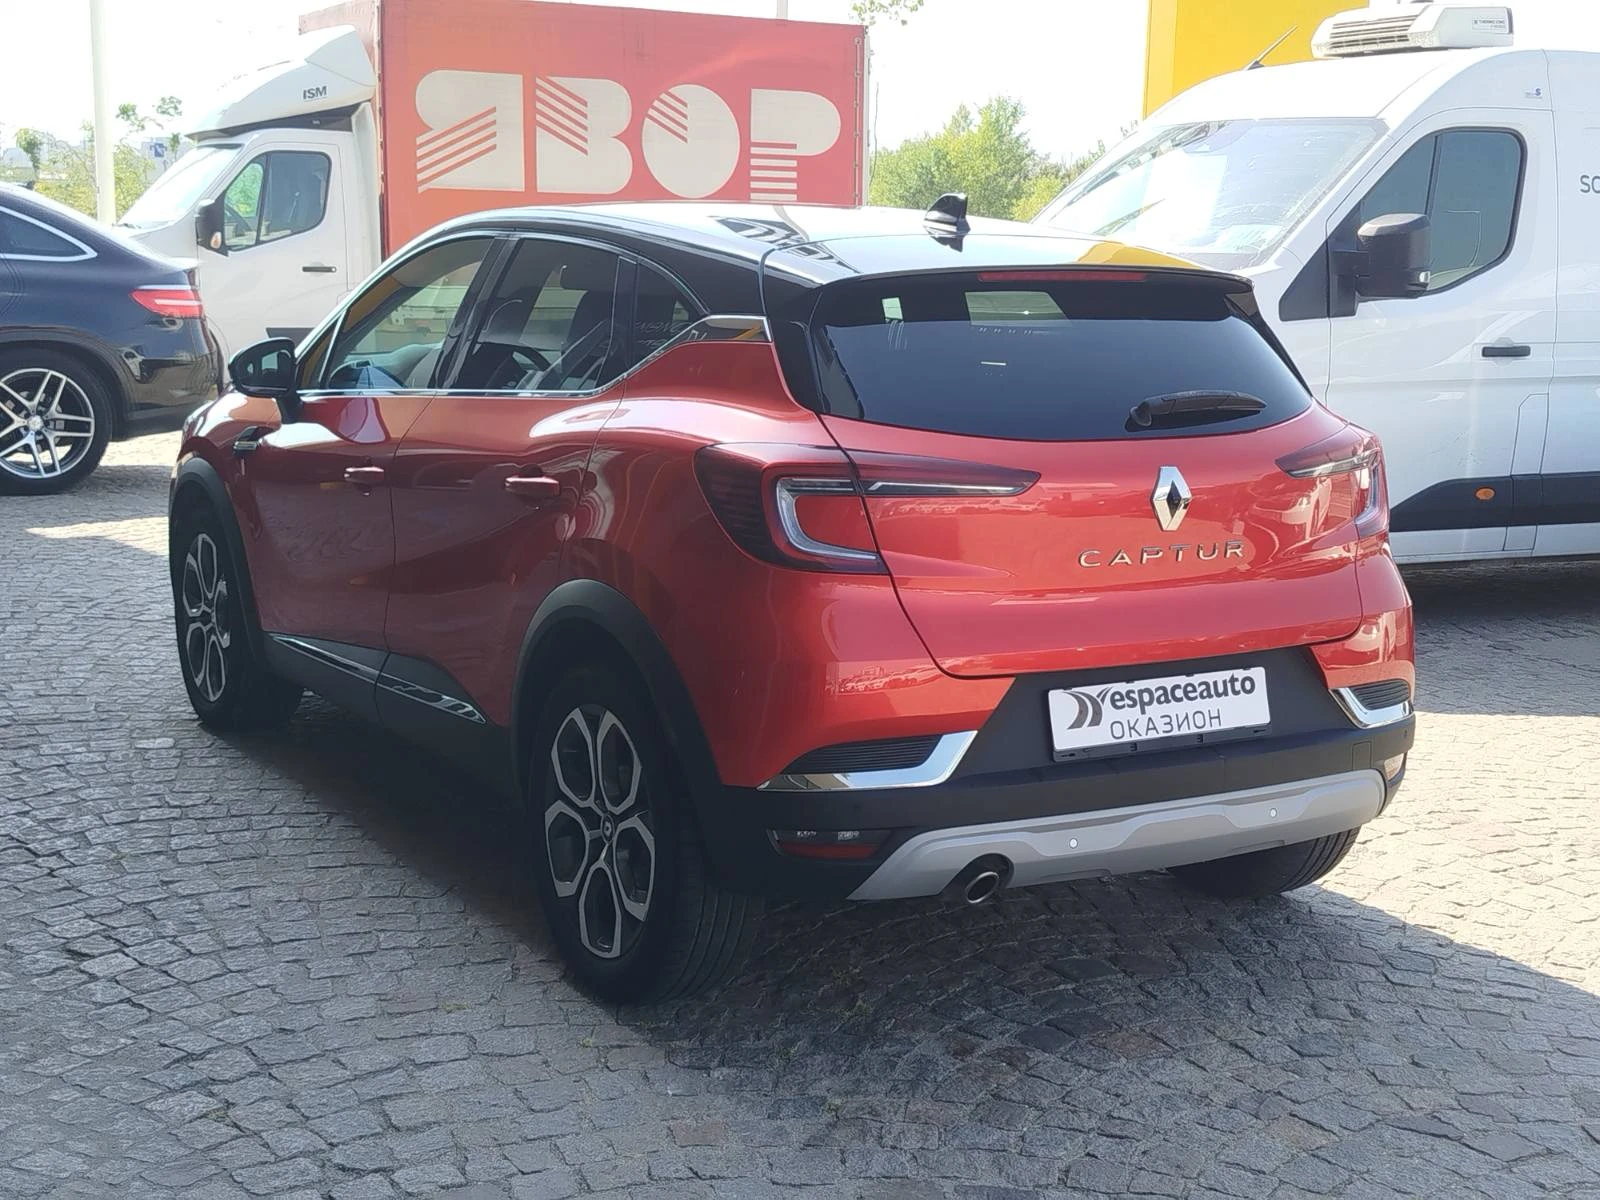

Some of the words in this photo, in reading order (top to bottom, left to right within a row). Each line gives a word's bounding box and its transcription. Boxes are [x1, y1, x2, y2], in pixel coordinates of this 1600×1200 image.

[303, 85, 327, 100] ISM
[415, 69, 841, 200] ЯВОР
[1078, 539, 1245, 568] CAPTUR
[1109, 673, 1256, 715] espaceauto
[1110, 708, 1222, 740] ОКАЗИОН
